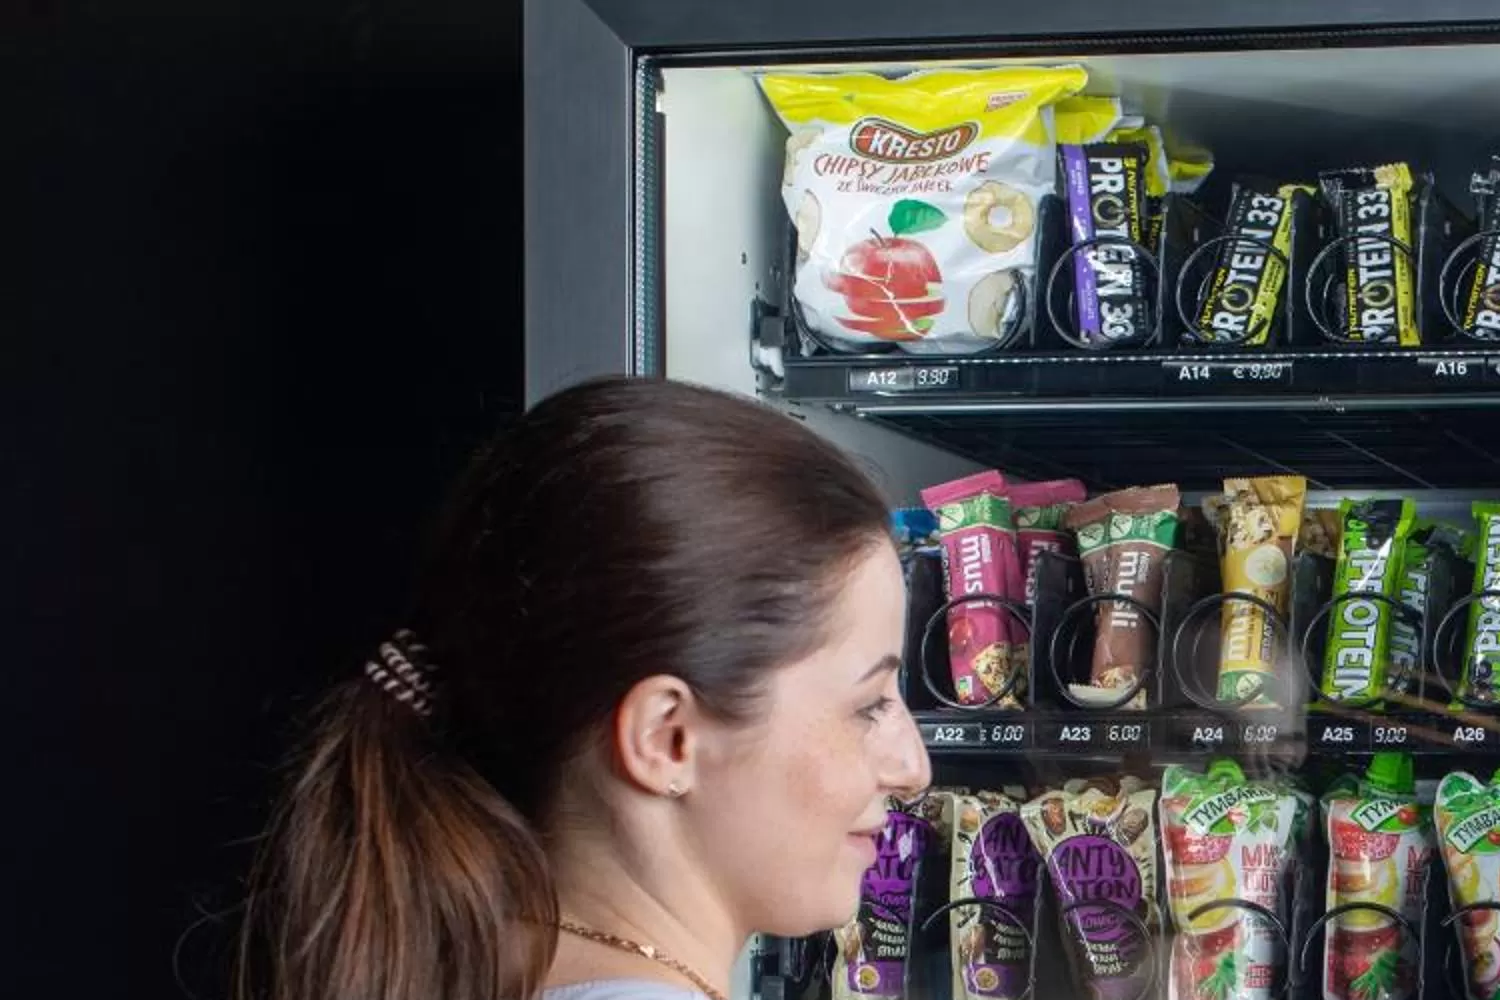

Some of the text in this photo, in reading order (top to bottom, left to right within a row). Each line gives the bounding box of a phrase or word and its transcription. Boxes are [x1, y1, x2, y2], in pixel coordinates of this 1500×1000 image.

[868, 128, 961, 159] KRESTO
[813, 152, 886, 179] CHIPSY
[1179, 365, 1210, 380] A14
[1435, 361, 1467, 376] A16
[867, 371, 897, 385] A12
[960, 535, 993, 610] musi
[934, 727, 964, 741] A22
[1059, 726, 1091, 741] A23
[1192, 727, 1224, 742] A24
[1321, 727, 1353, 742] A25
[1453, 727, 1485, 741] A26
